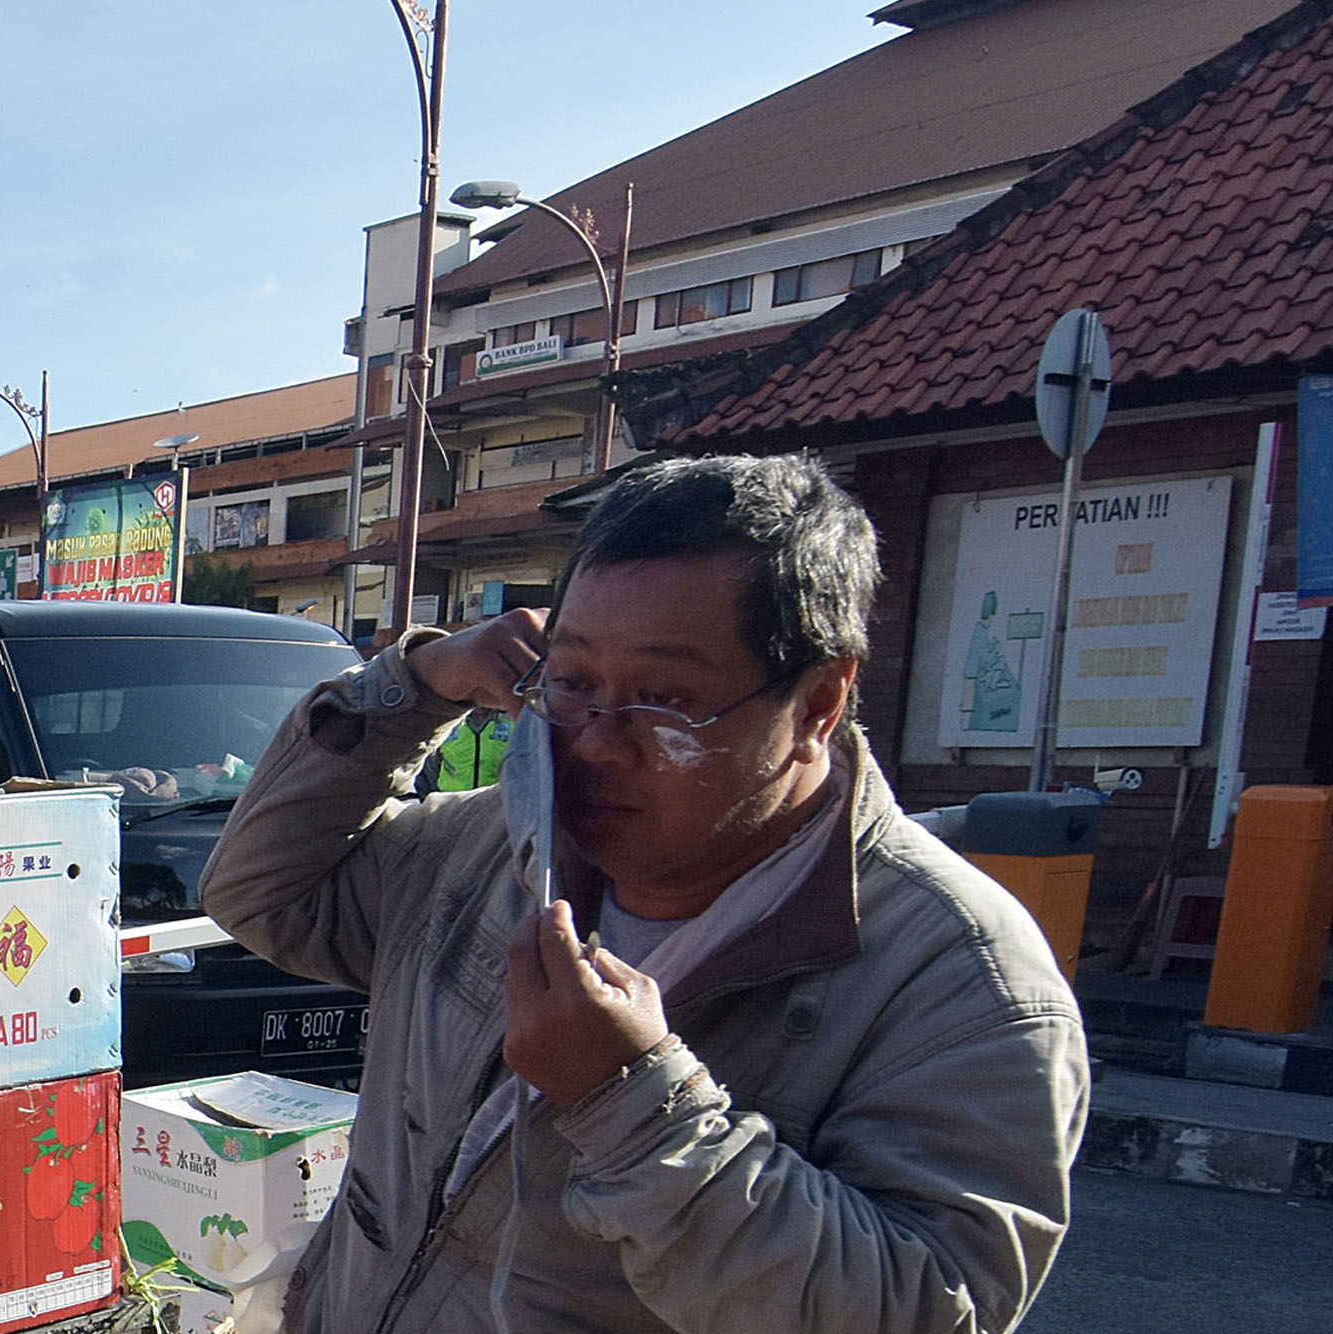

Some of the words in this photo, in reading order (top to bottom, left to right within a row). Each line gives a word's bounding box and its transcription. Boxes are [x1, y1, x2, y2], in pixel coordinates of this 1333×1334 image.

[495, 349, 518, 359] BANK
[1015, 496, 1141, 530] PERATIAN
[48, 559, 97, 587] WAJIB
[99, 550, 165, 582] MASKER
[266, 1014, 288, 1040] DK
[301, 1010, 344, 1037] 8007
